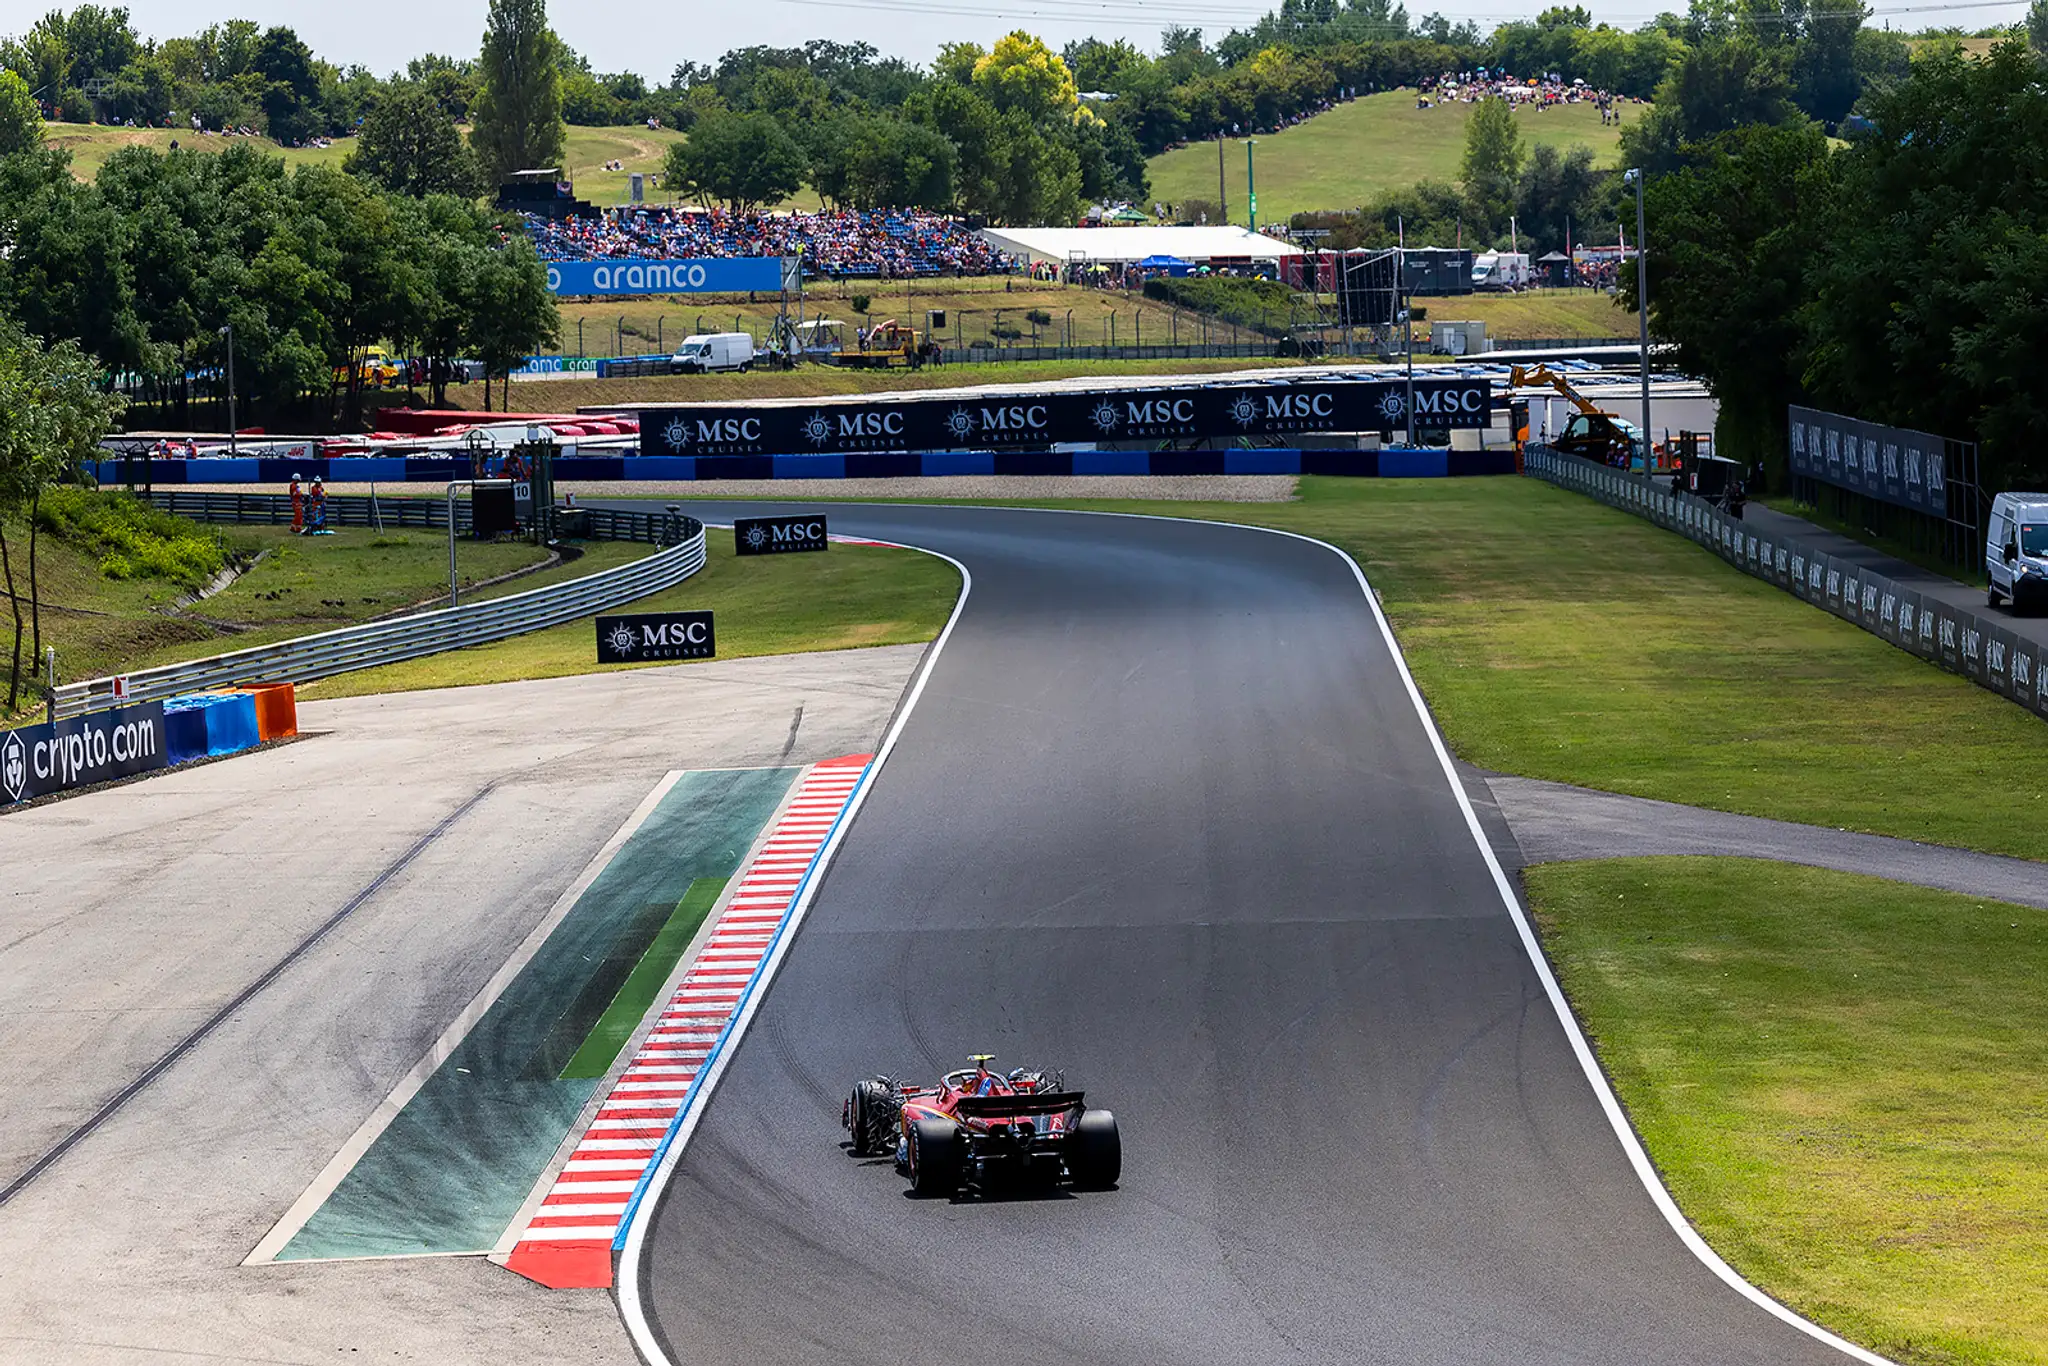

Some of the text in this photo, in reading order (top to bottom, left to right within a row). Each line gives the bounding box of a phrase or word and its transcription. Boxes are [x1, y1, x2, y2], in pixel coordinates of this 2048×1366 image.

[593, 264, 706, 289] aramco
[1126, 399, 1194, 424] MSC
[1265, 393, 1334, 419] MSC
[1413, 389, 1482, 414] MSC
[696, 418, 761, 442] MSC
[837, 412, 904, 436] MSC
[980, 406, 1048, 430] MSC
[516, 486, 529, 497] 10
[771, 523, 822, 542] MSC
[641, 622, 707, 647] MSC
[642, 647, 708, 658] CRUISES
[33, 718, 156, 784] crypto.com
